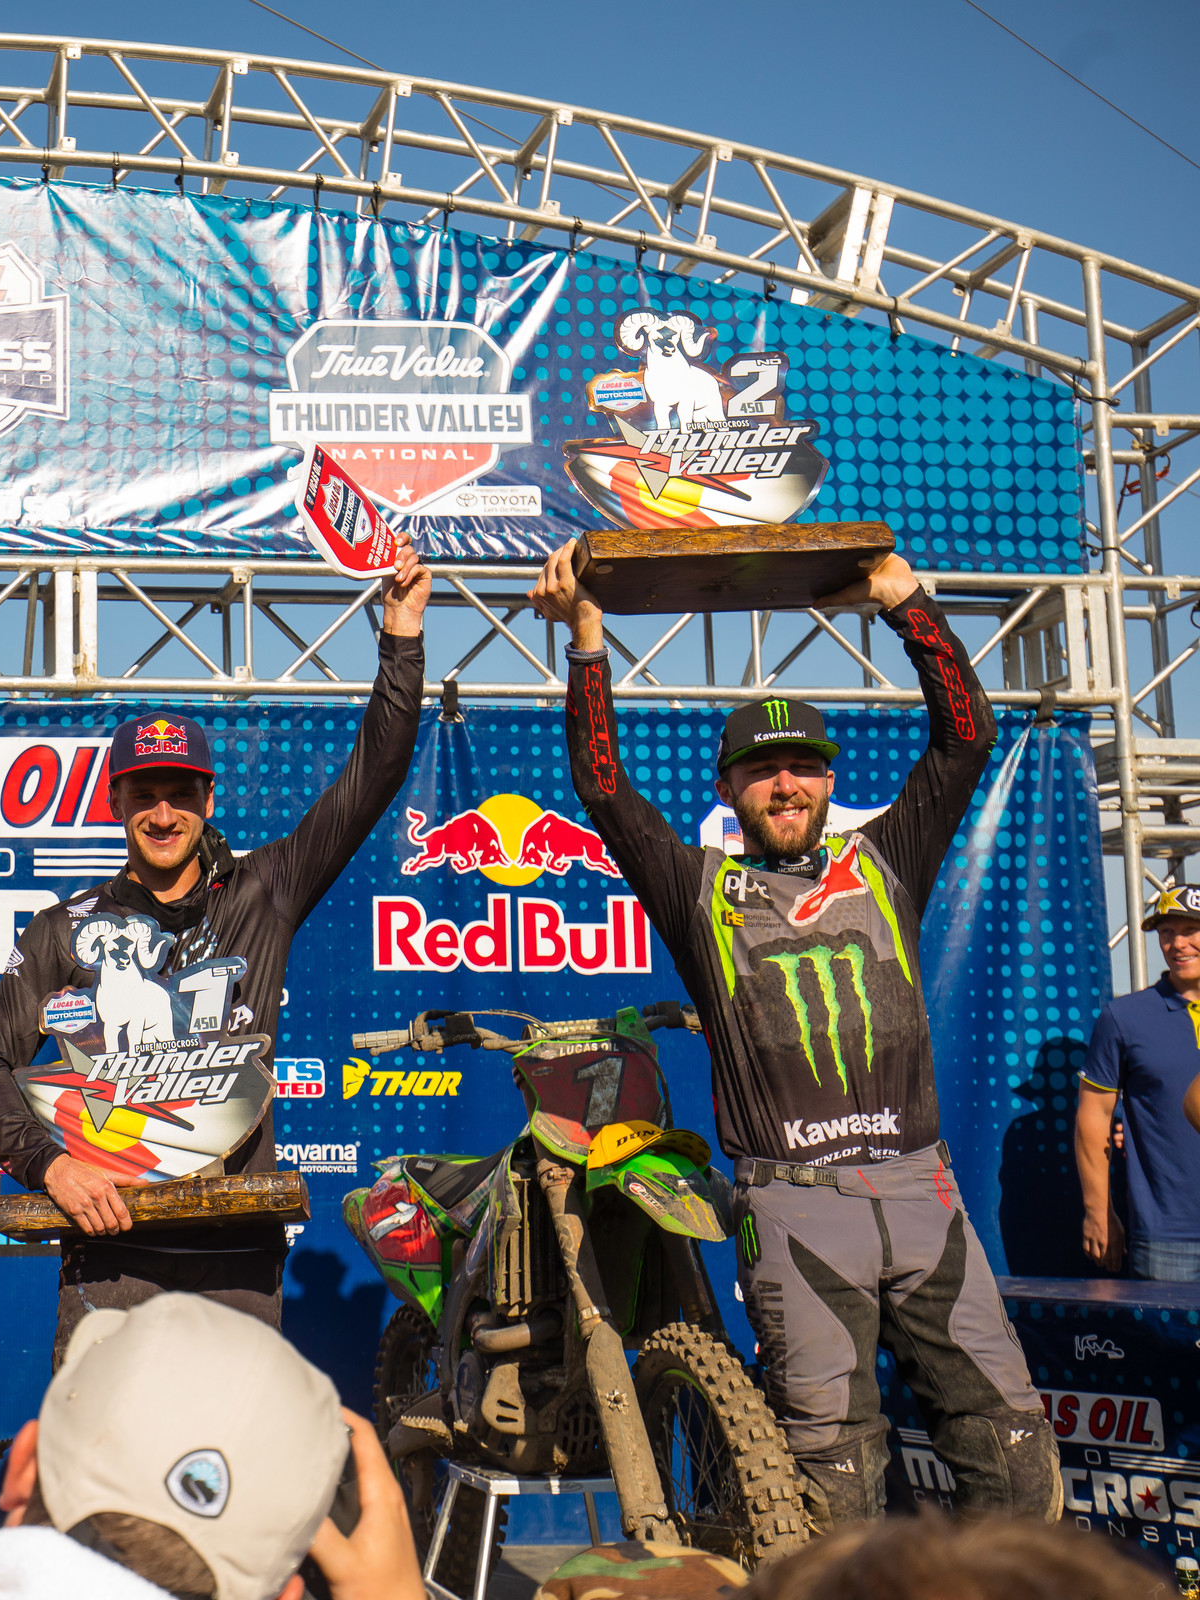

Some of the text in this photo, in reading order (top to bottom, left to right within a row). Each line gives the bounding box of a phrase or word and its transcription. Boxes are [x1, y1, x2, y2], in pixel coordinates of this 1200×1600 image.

[597, 390, 643, 400] MOTOCROSS
[740, 401, 764, 413] 450
[276, 404, 523, 432] THUNDER VALLEY
[686, 420, 750, 431] PURE MOTOCROSS
[639, 423, 812, 455] Thunder
[332, 448, 474, 460] NATIONAL
[668, 448, 792, 478] Valley
[481, 495, 538, 505] TOYOTA
[754, 730, 806, 743] Kawasaki
[135, 740, 188, 756] Red Bull
[373, 894, 652, 974] Red Bull
[52, 1000, 73, 1009] LUCAS
[47, 1010, 92, 1021] MOTOCROSS
[194, 1016, 218, 1031] 450
[135, 1038, 199, 1053] PURE MOTOCROSS
[559, 1042, 619, 1057] LUCAS OIL
[85, 1041, 261, 1083] Thunder
[112, 1070, 240, 1107] Valley
[370, 1070, 463, 1097] THOR
[575, 1056, 625, 1128] 1
[783, 1107, 901, 1149] Kawasak
[274, 1143, 357, 1166] sqvarna
[806, 1146, 862, 1166] DUNLOP
[299, 1164, 357, 1174] MOTORCYCLES
[1088, 1397, 1154, 1444] OIL
